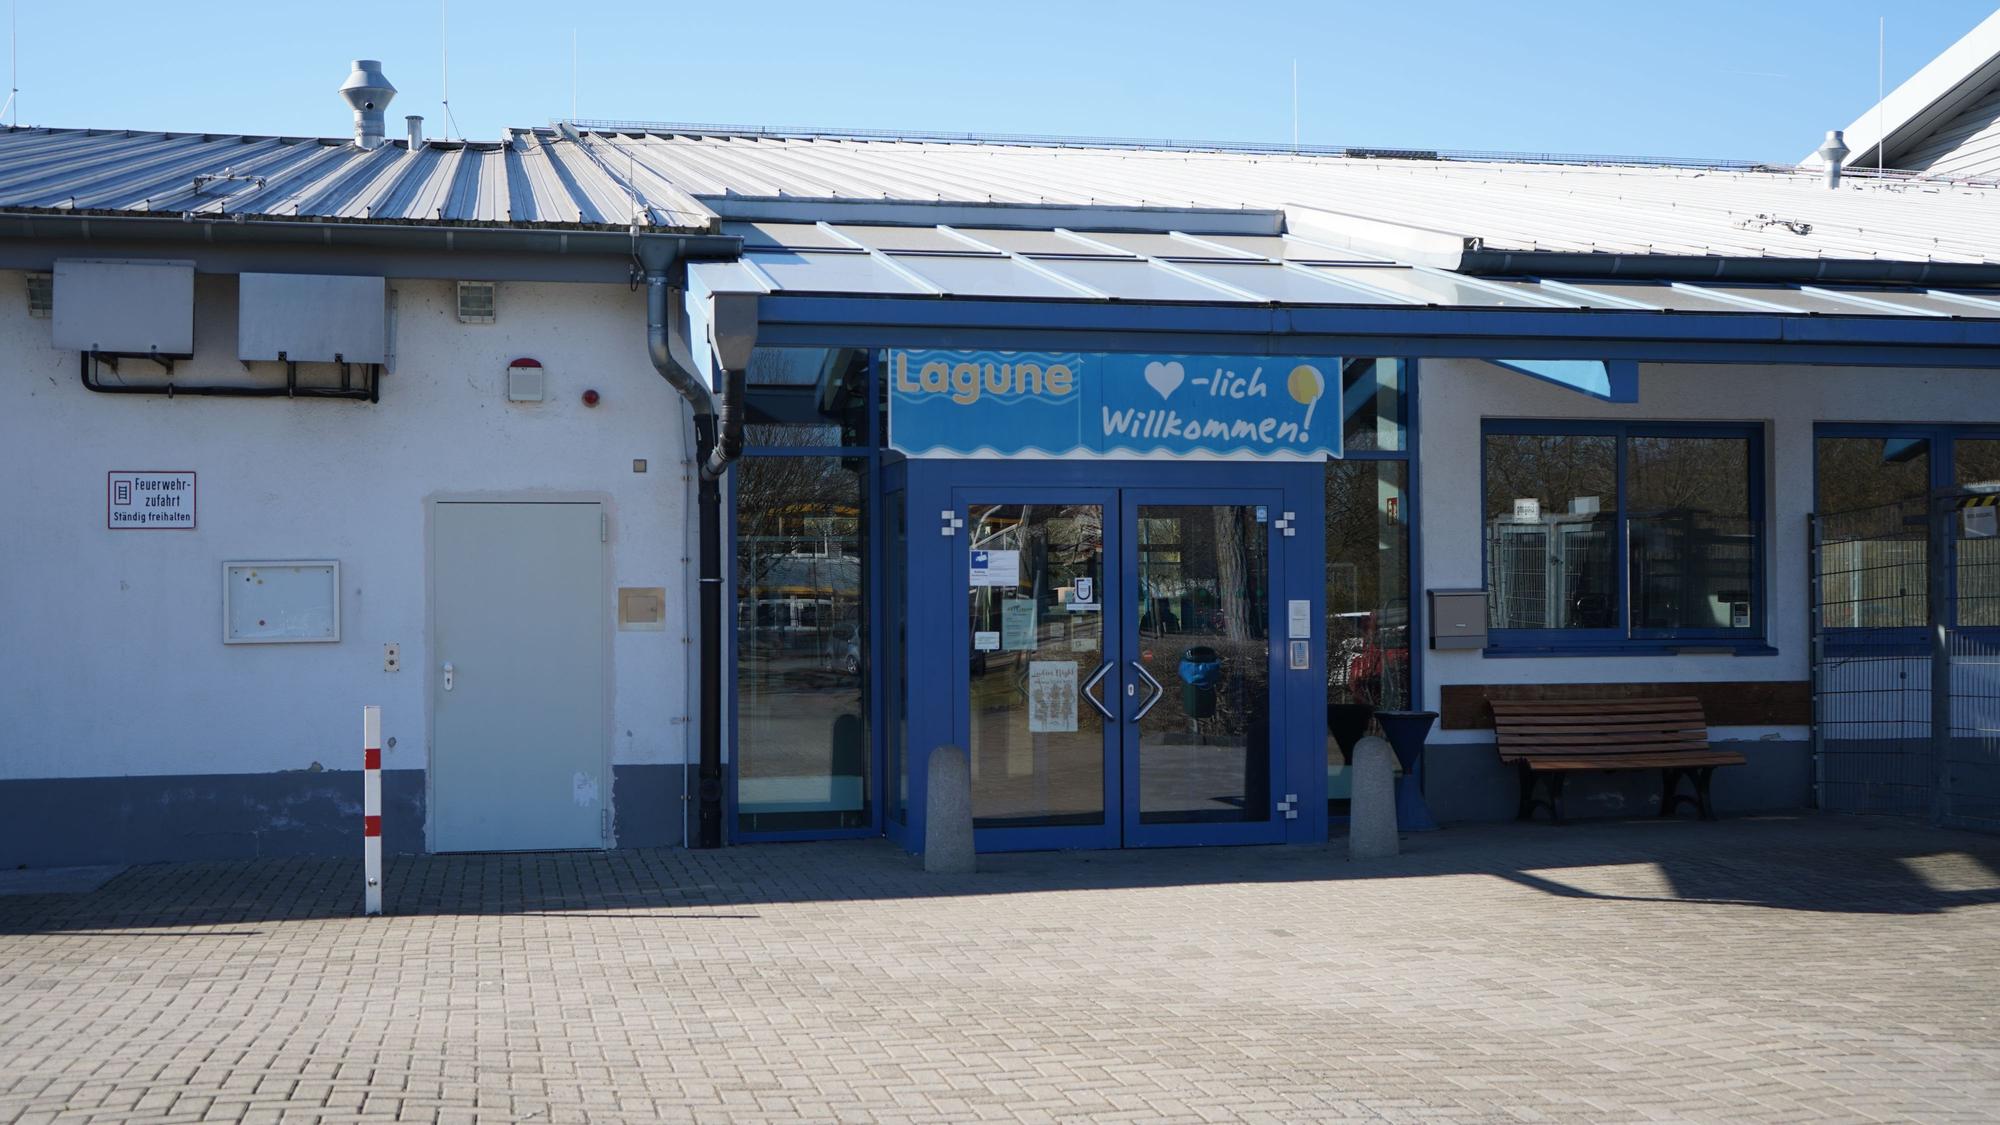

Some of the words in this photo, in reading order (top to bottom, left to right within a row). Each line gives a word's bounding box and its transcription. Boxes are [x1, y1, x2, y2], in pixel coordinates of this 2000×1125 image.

[897, 352, 1072, 405] Lagune
[1102, 396, 1317, 444] Willkommen!
[135, 478, 191, 490] Feuerwehr-
[145, 494, 180, 507] zufahrt
[113, 512, 146, 523] Ständig
[148, 512, 191, 521] freihalten
